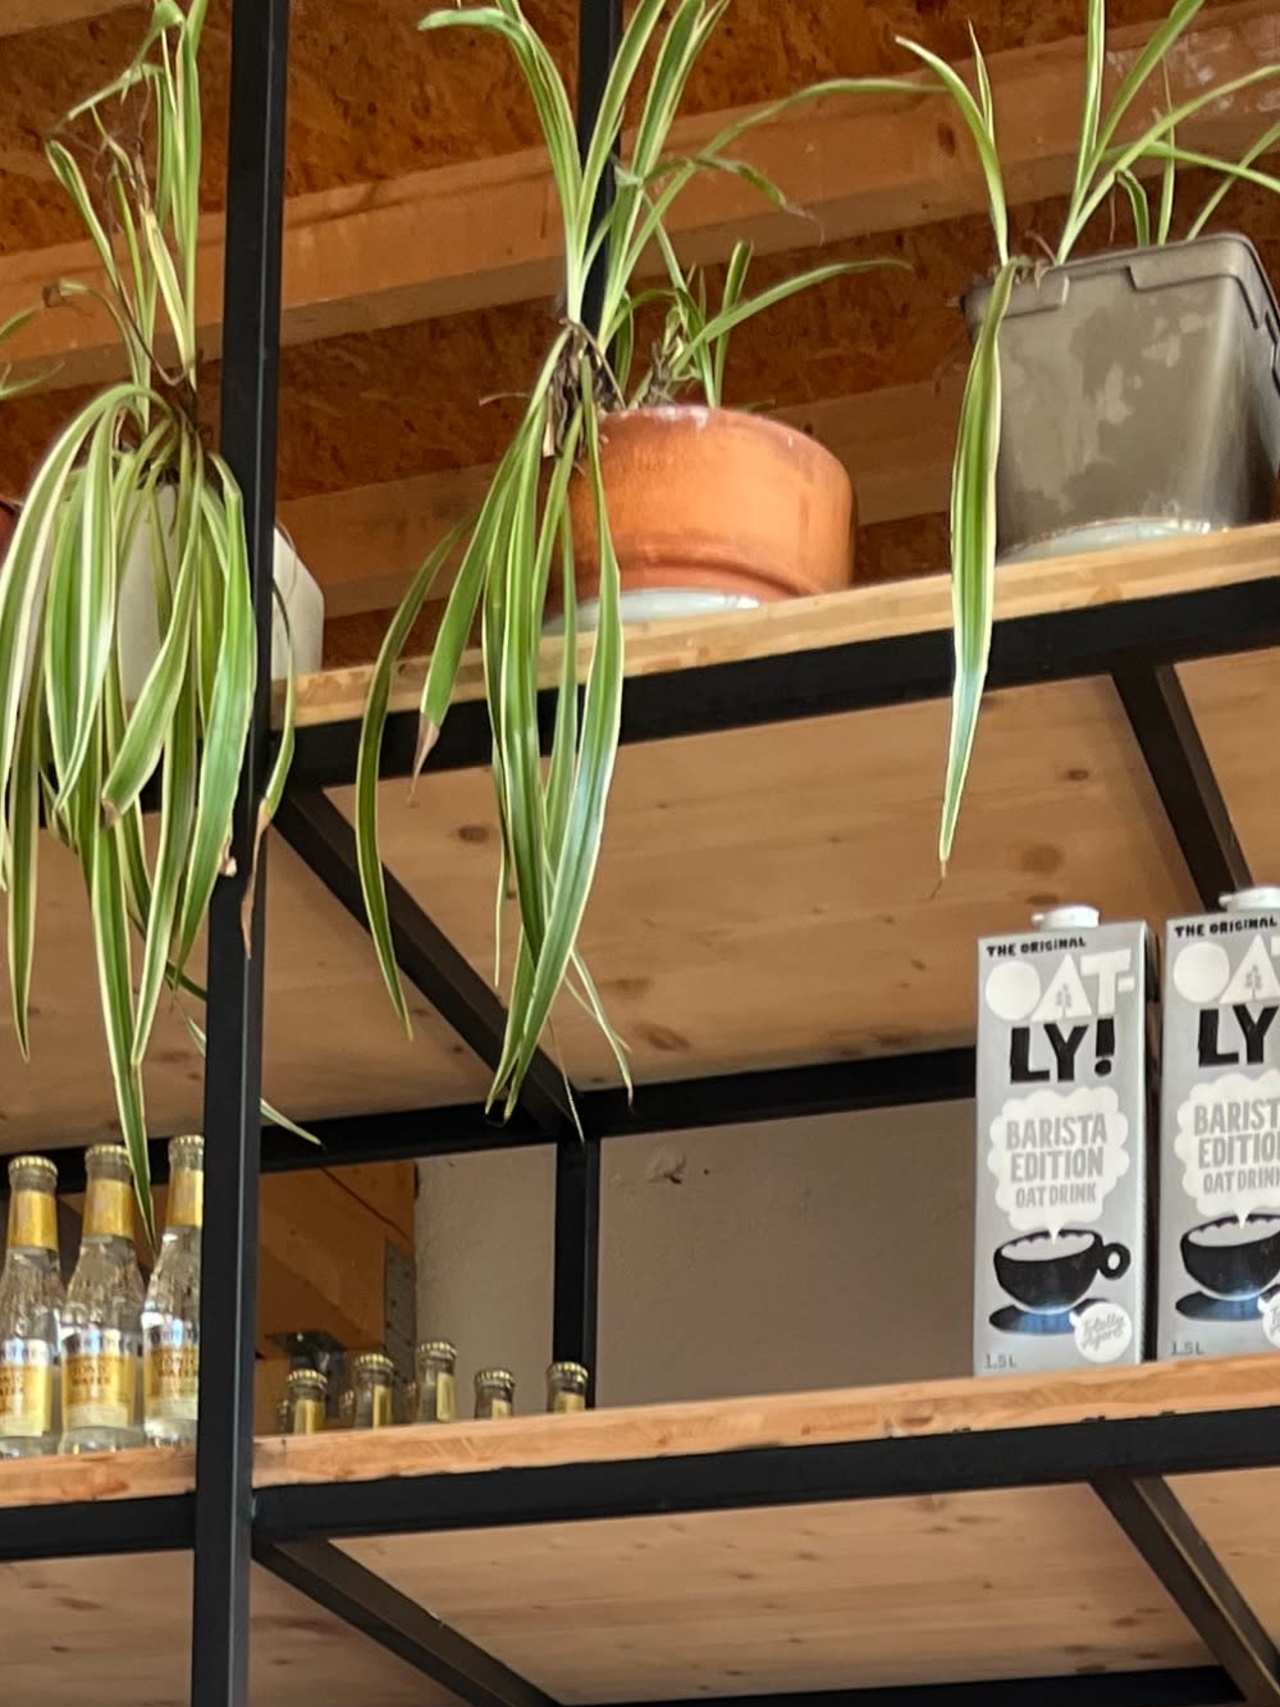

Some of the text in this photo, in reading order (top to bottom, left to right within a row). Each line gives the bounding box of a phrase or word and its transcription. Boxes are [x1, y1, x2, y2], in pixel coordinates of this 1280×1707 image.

[1174, 923, 1205, 940] THE
[986, 946, 1016, 957] THE
[1010, 1016, 1116, 1085] LY!
[1006, 1113, 1108, 1151] BARISTA
[1010, 1146, 1104, 1183] EDITION
[1015, 1182, 1097, 1208] OAT DRINK
[1203, 1171, 1236, 1195] OAT
